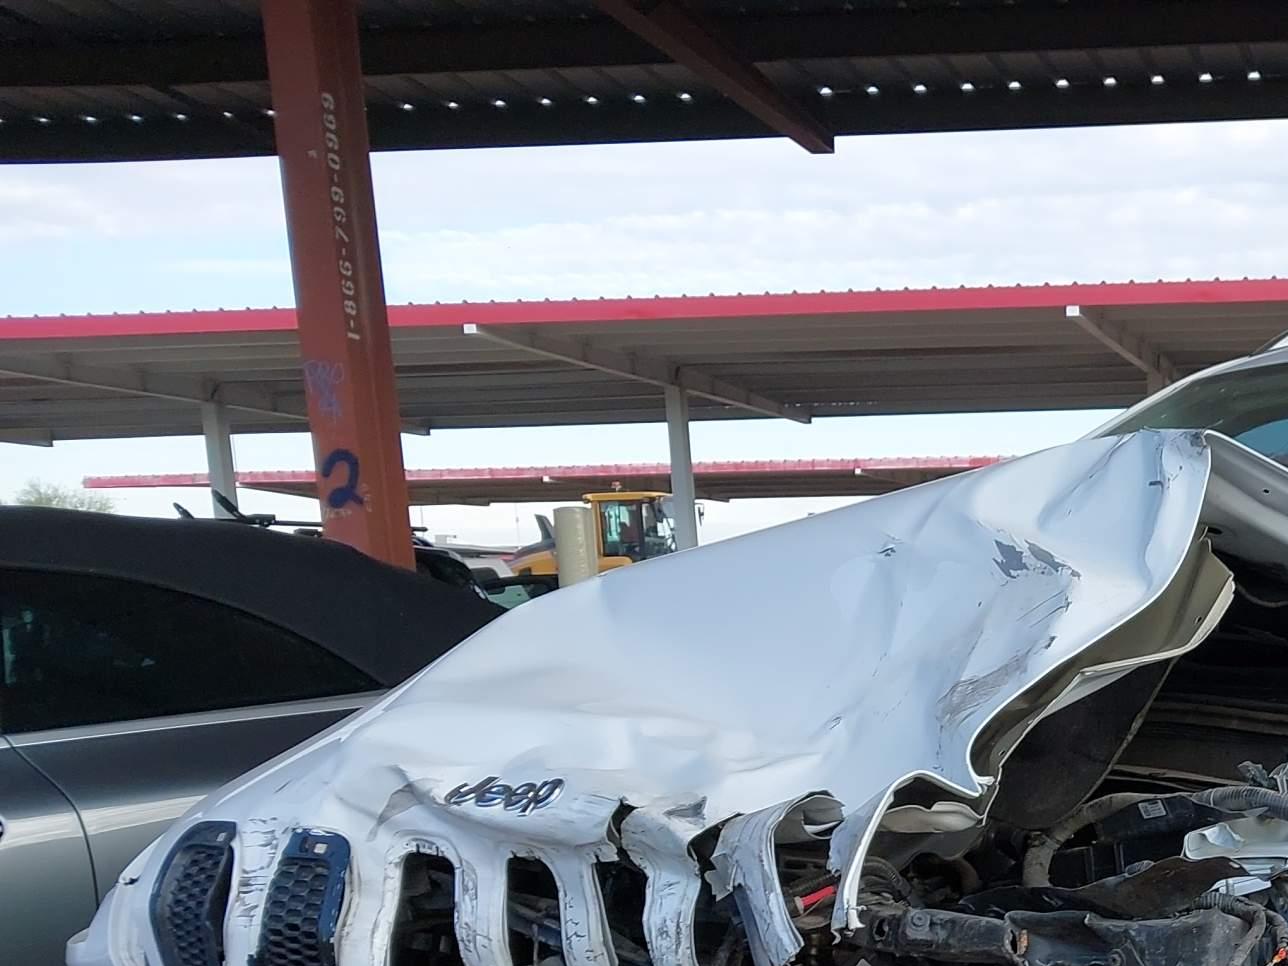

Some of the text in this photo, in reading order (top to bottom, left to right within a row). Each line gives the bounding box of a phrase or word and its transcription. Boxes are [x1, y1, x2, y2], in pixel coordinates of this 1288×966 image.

[321, 93, 360, 341] 1-866-799-0969
[321, 448, 364, 509] 2
[444, 776, 566, 817] Jeep
